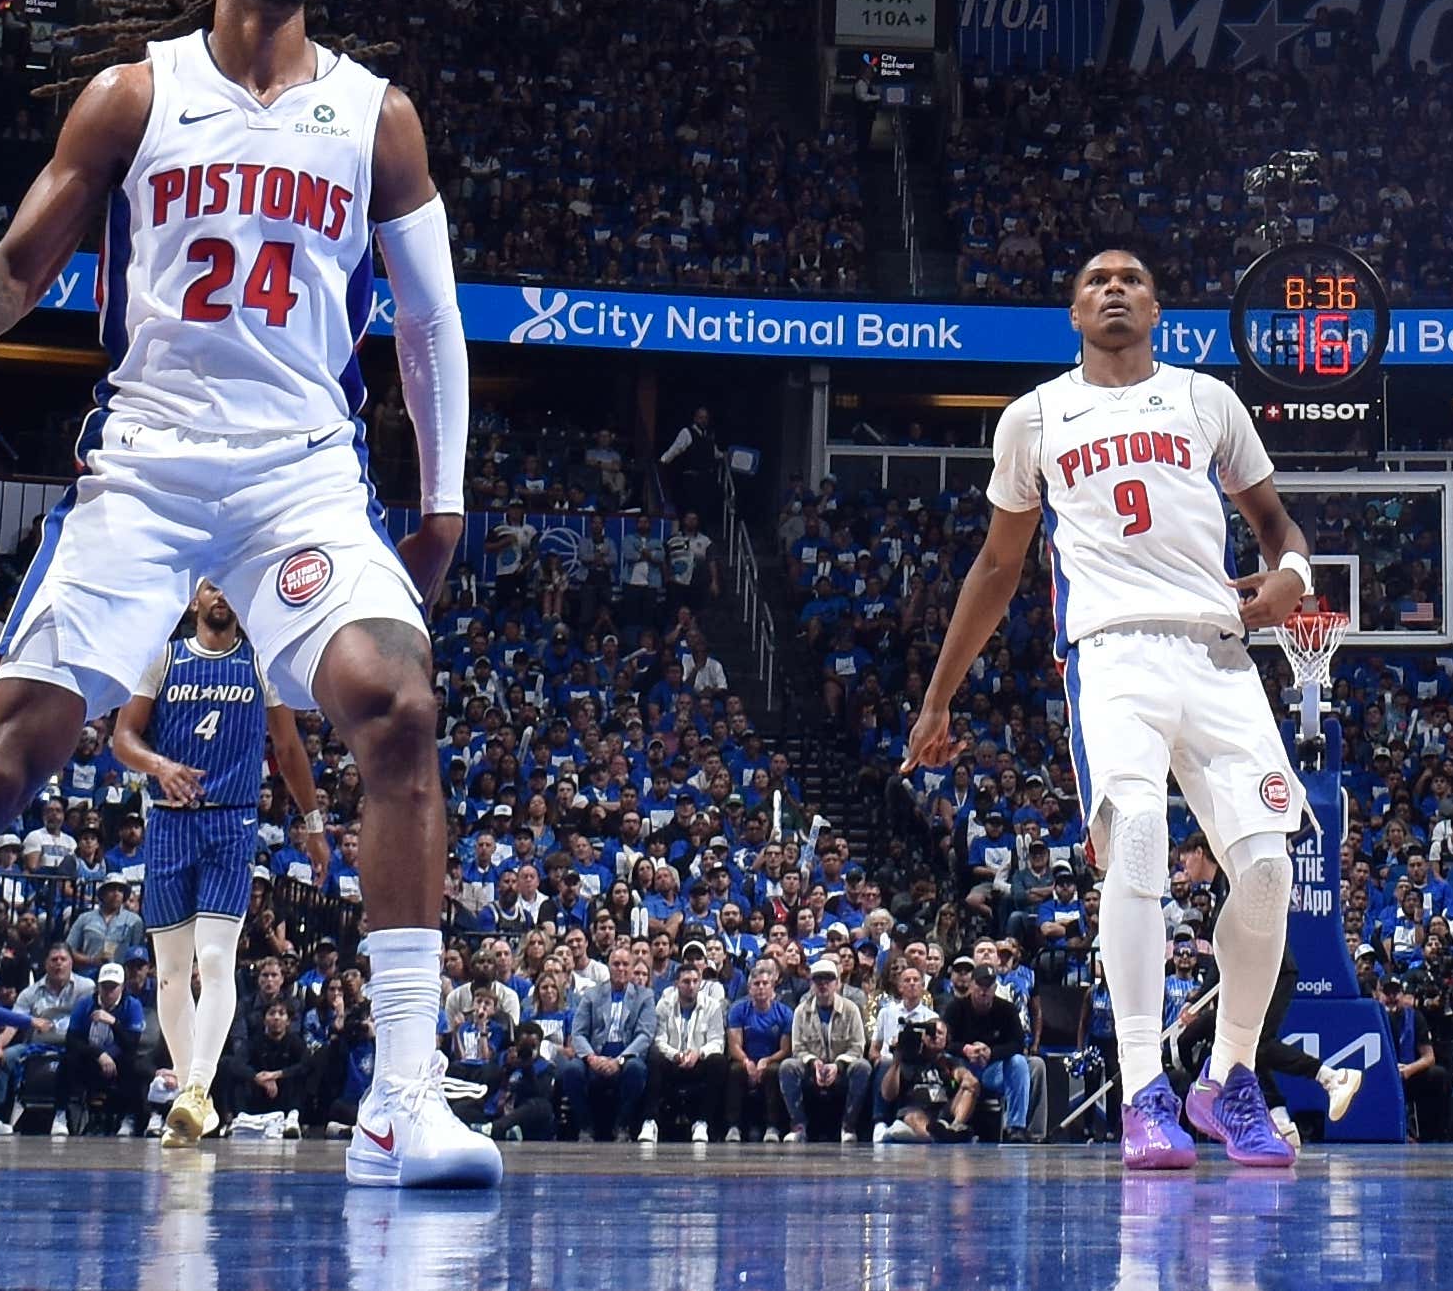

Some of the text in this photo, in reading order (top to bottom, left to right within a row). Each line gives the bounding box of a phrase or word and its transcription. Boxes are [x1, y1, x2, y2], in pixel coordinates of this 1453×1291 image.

[862, 10, 911, 26] 110A
[147, 162, 353, 242] PISTONS
[181, 237, 299, 328] 24
[1284, 275, 1358, 311] 8:36
[566, 300, 961, 350] City National Bank
[1297, 313, 1350, 377] 16
[1283, 403, 1370, 420] TISSOT
[1056, 430, 1192, 489] PISTONS
[1113, 478, 1152, 537] 9
[194, 710, 220, 740] 4
[1296, 857, 1325, 882] THE
[1303, 884, 1332, 916] App
[1297, 978, 1332, 995] oogle
